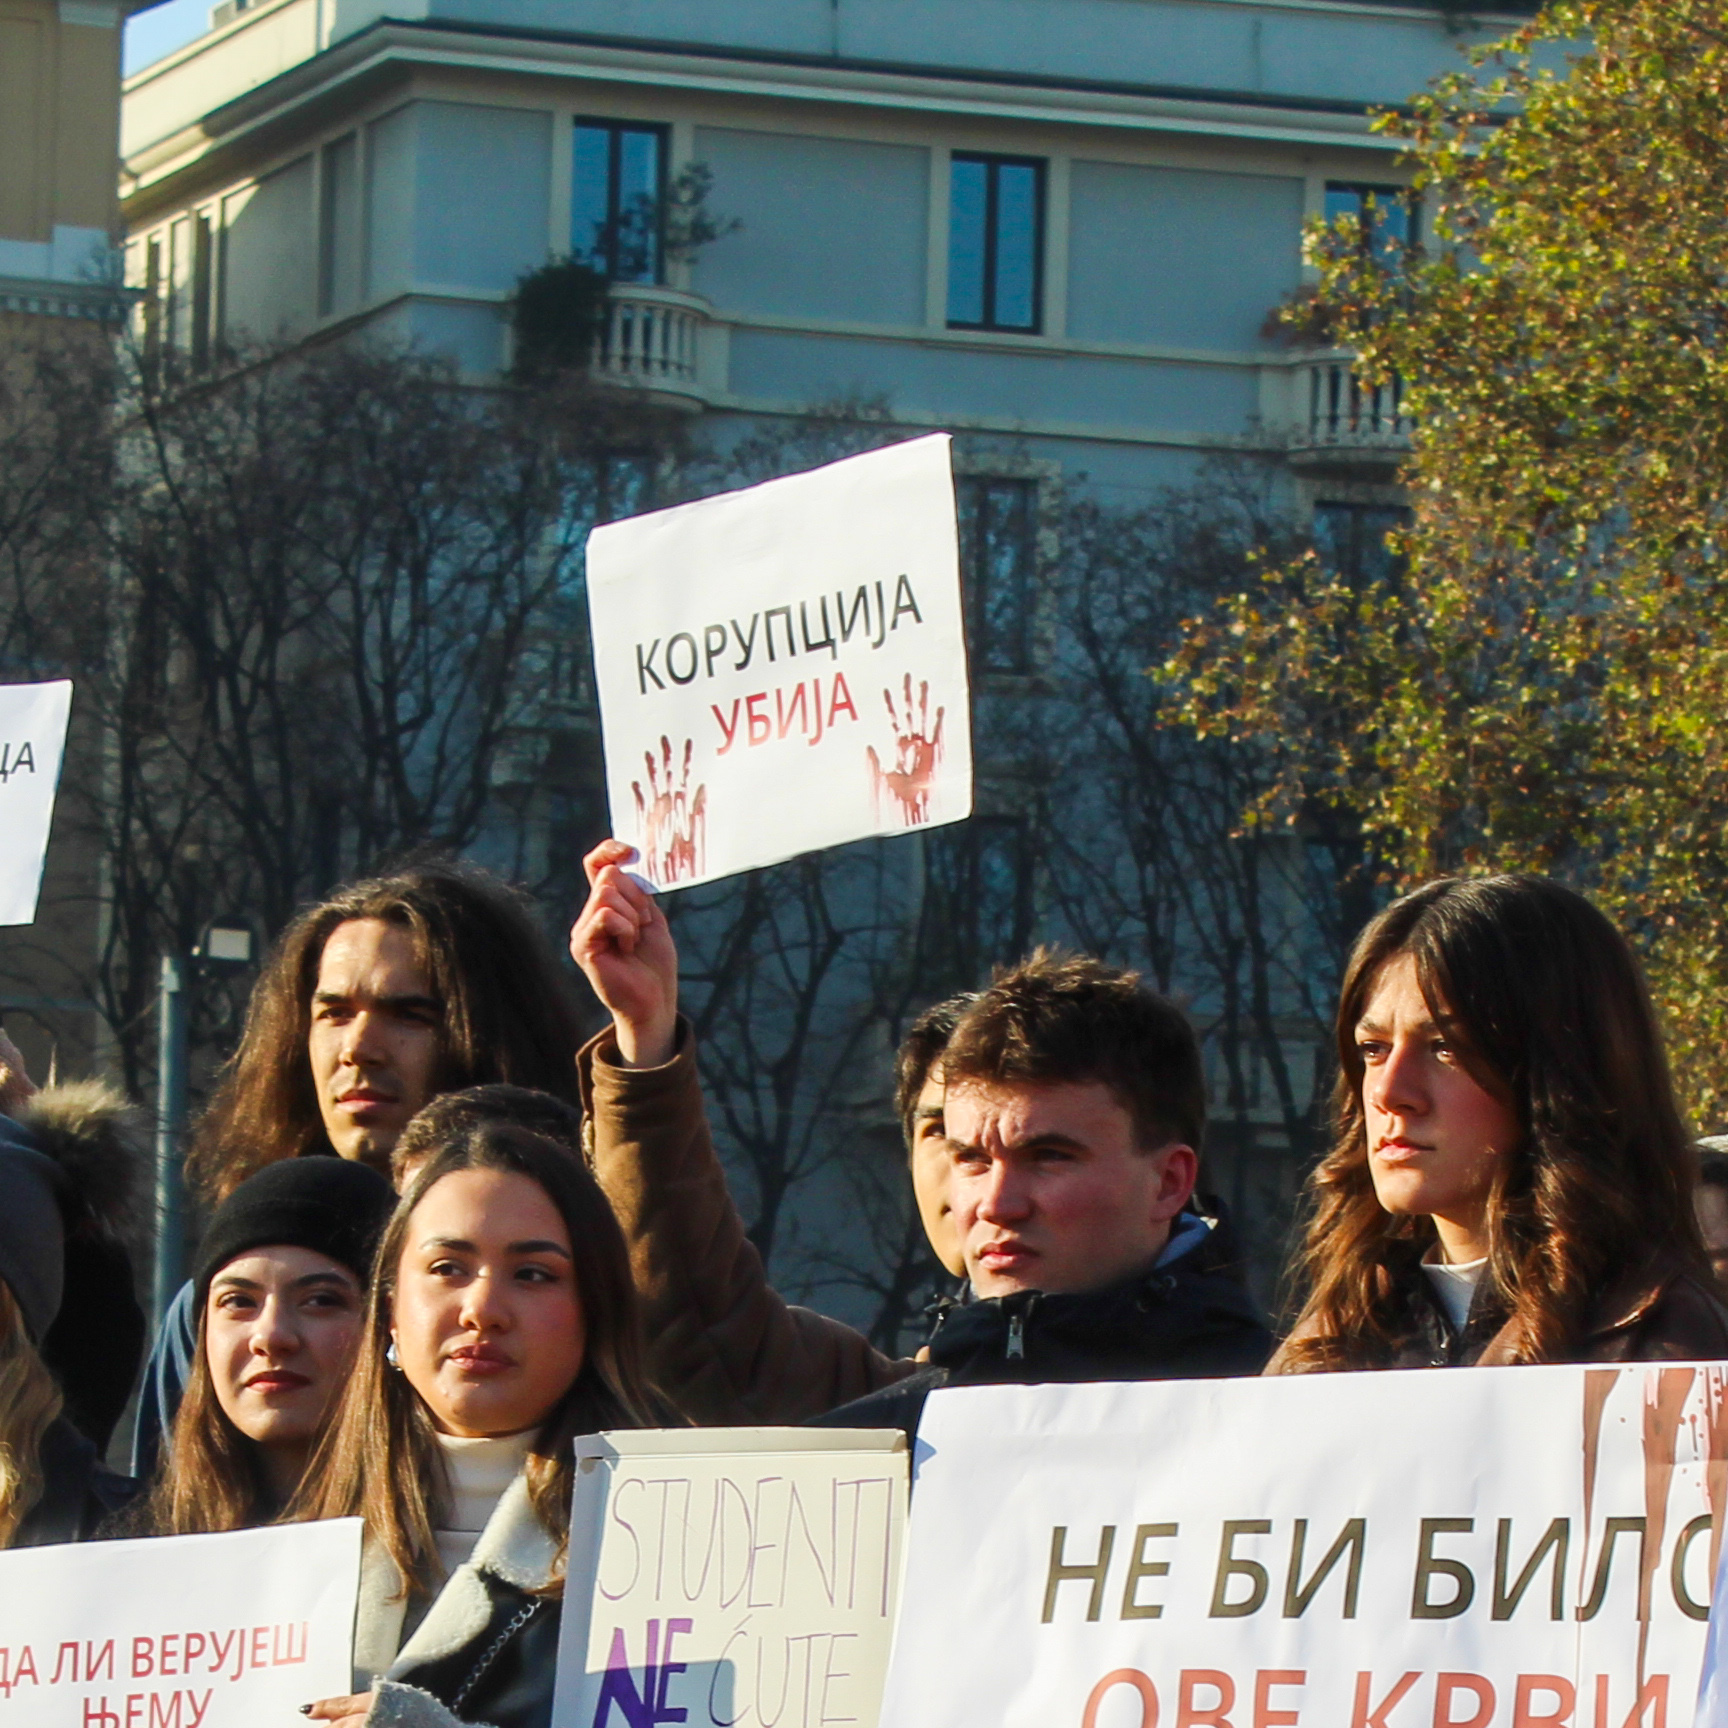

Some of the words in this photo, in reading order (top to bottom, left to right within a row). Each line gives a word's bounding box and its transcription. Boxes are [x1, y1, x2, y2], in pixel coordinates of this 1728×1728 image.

[635, 573, 924, 695] КОРУПЦИЈА
[710, 671, 859, 757] УБИЈА
[598, 1476, 894, 1618] STUDENTI
[1039, 1521, 1181, 1627] НЕ
[1205, 1516, 1368, 1622] БИ
[49, 1639, 115, 1685] ЛИ
[131, 1620, 310, 1683] ВЕРУЈЕШ
